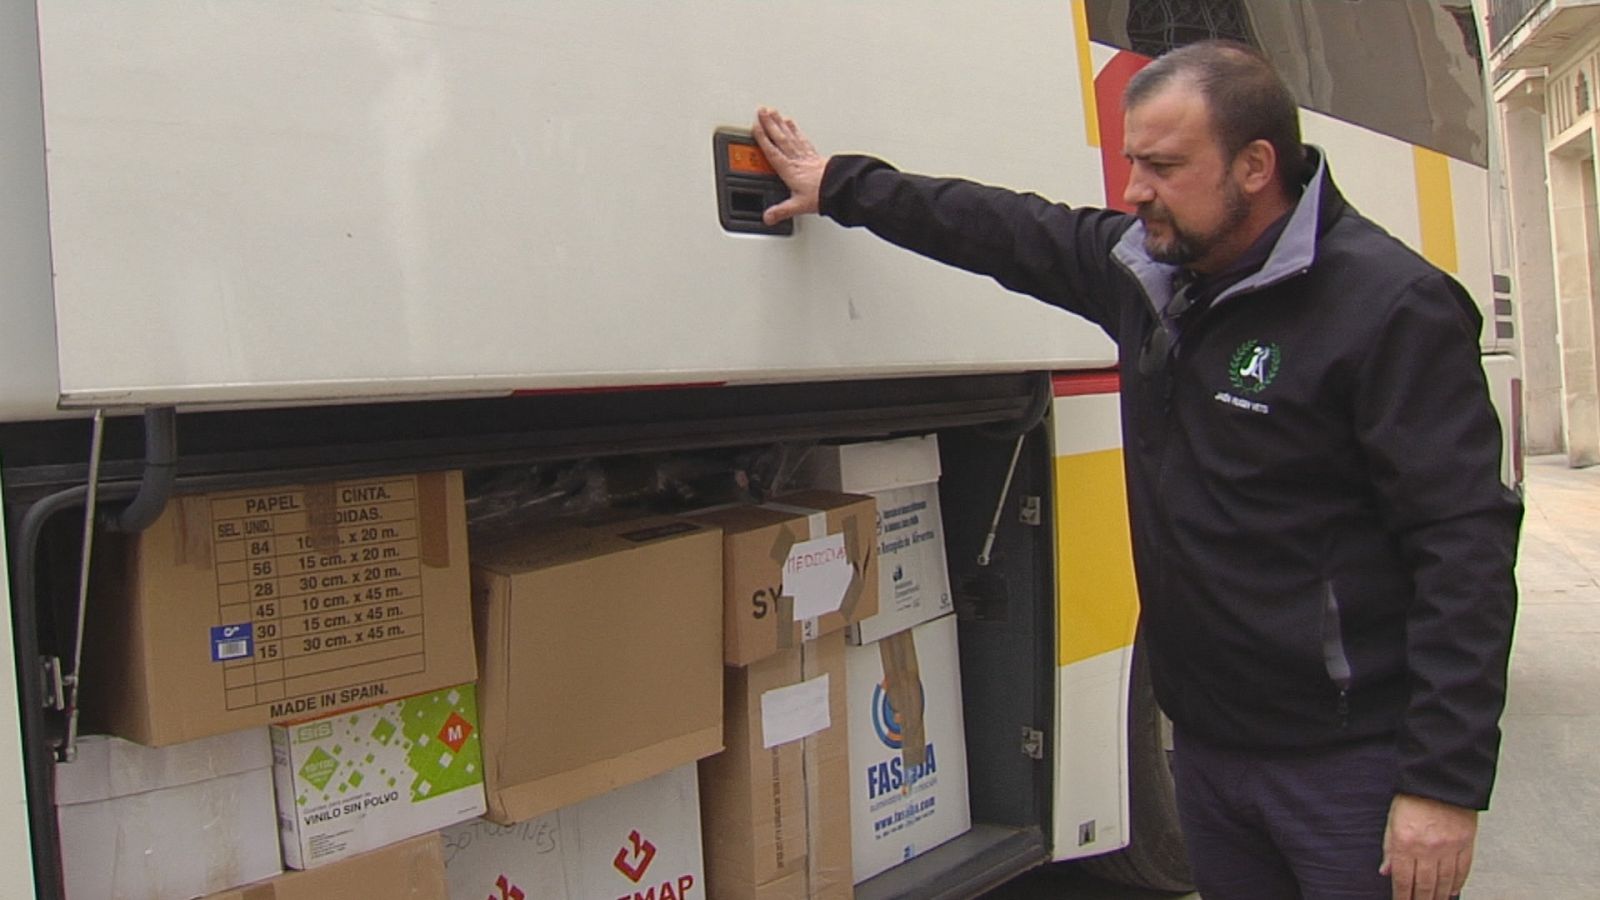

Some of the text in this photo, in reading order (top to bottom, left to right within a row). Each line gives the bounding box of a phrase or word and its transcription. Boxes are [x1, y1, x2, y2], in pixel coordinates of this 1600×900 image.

[246, 486, 391, 513] PAPEL CINTA.
[349, 533, 357, 543] x
[361, 528, 378, 541] 20
[382, 527, 399, 538] m.
[251, 541, 269, 555] 84
[253, 561, 272, 575] 56
[300, 547, 400, 570] 15 cm. x 20 m.
[300, 567, 401, 590] 30 cm. x 20 m.
[255, 582, 273, 596] 28
[303, 587, 402, 611] 10 cm. x 45 m.
[256, 603, 274, 617] 45
[304, 606, 403, 631] 15 cm. x 45 m.
[257, 624, 276, 638] 30
[304, 625, 405, 652] 30 cm. x 45 m.
[259, 644, 277, 658] 15
[270, 683, 388, 718] MADE IN SPAIN.
[448, 724, 463, 742] M
[304, 807, 341, 825] VINILO
[343, 802, 361, 815] SIN
[364, 791, 399, 809] POLVO
